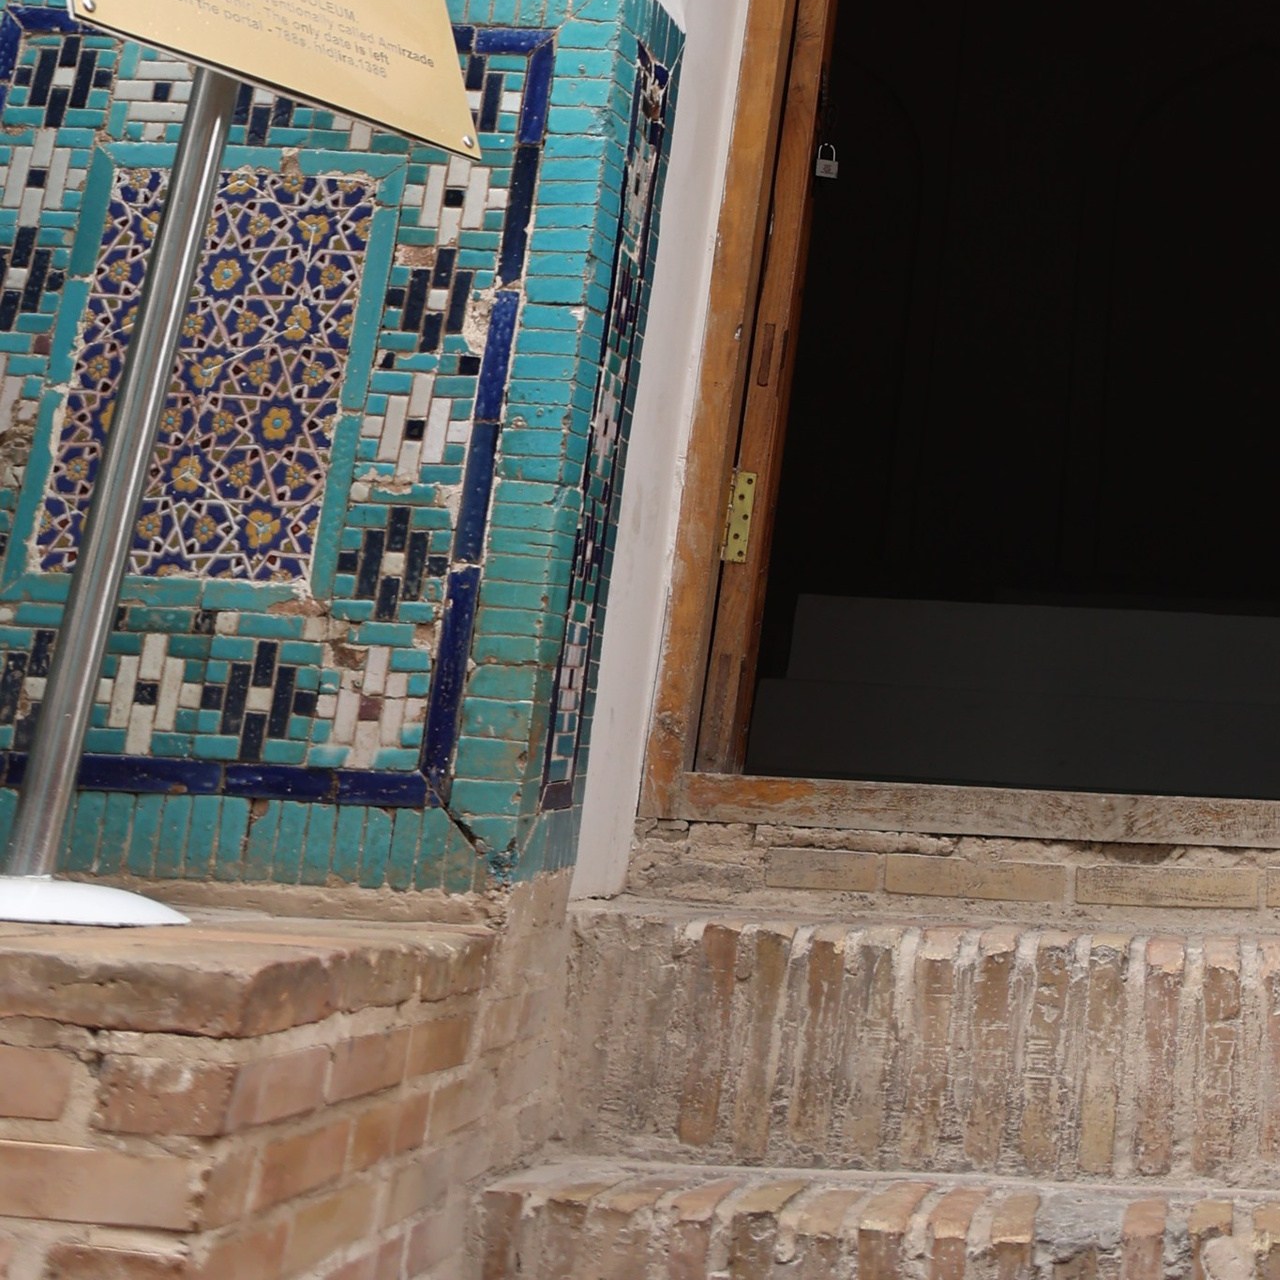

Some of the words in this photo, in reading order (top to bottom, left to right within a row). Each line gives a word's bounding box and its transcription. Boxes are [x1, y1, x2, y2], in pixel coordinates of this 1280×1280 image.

[222, 6, 264, 35] portal
[263, 5, 289, 27] The
[291, 18, 322, 42] only
[323, 30, 353, 52] date
[368, 46, 391, 66] left
[337, 20, 375, 45] called
[377, 35, 435, 69] Amirzade
